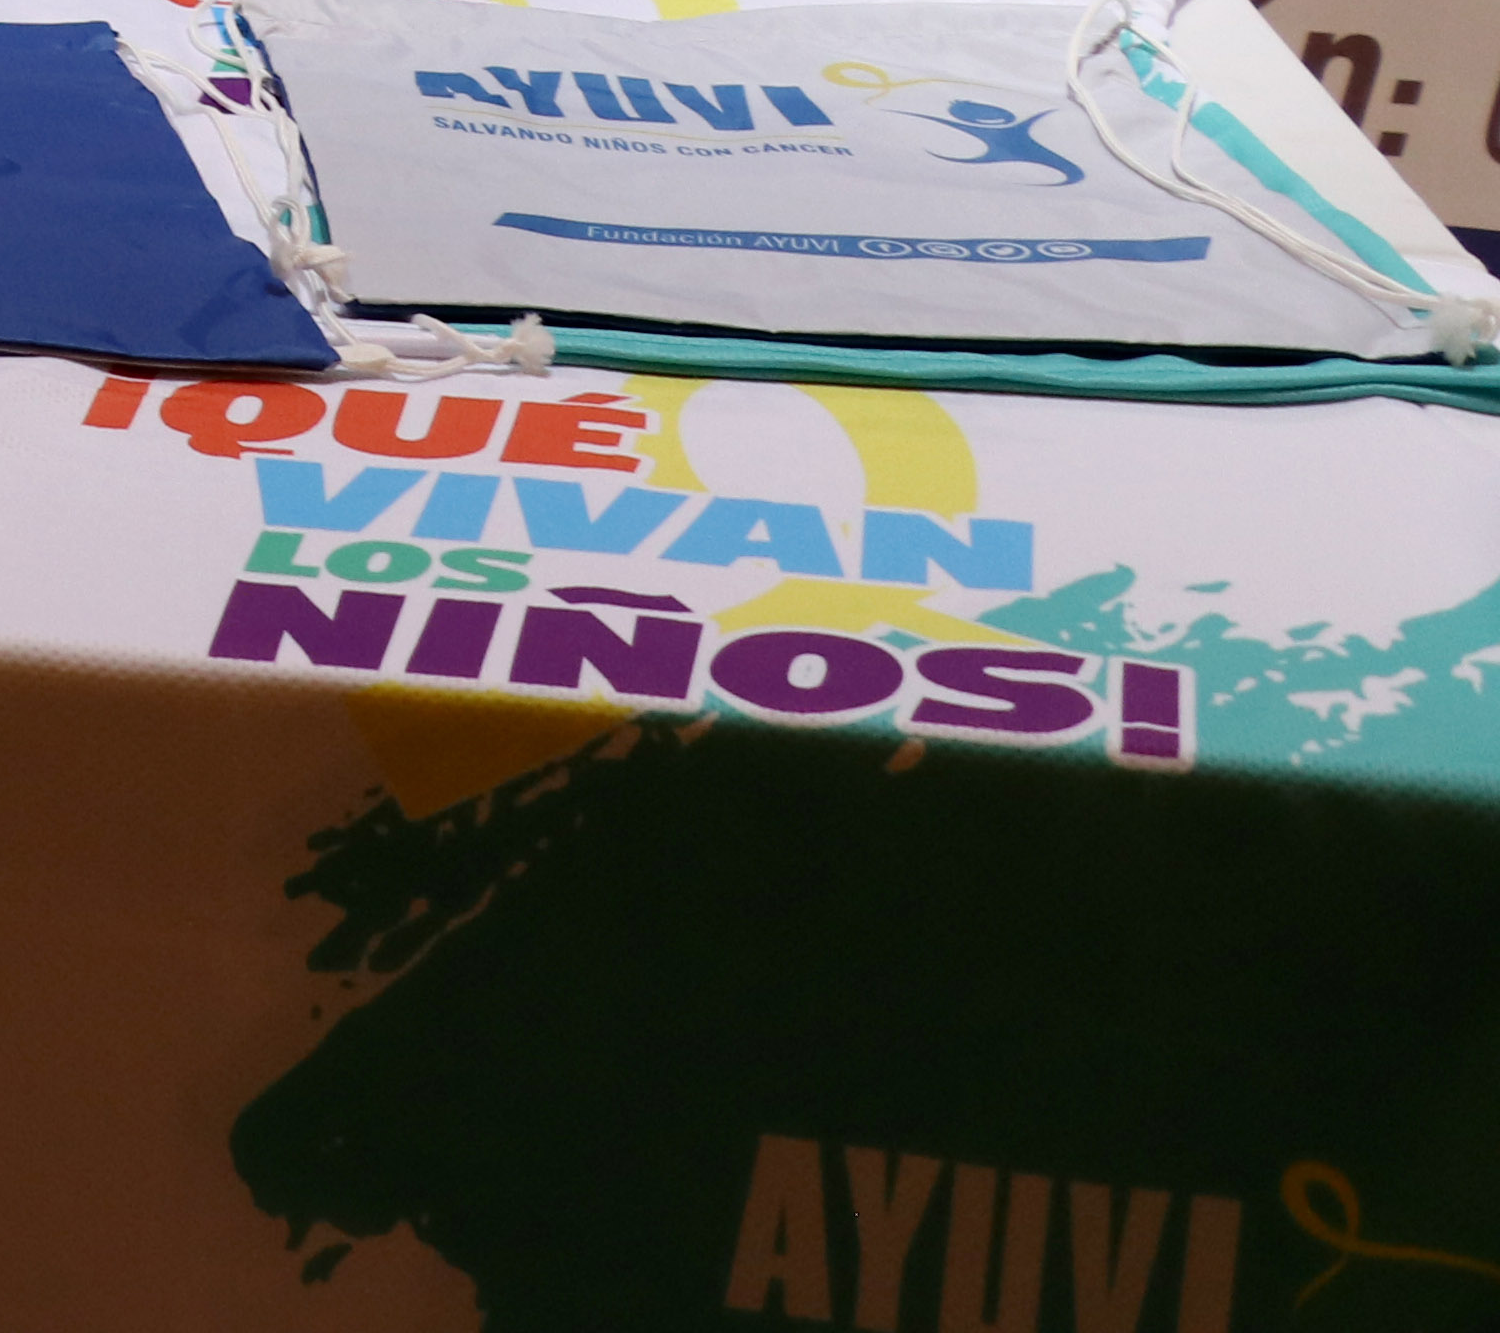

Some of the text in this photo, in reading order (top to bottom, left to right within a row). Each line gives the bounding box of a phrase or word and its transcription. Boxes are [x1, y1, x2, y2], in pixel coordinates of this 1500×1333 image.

[414, 65, 836, 132] AYUVI
[432, 115, 855, 158] SALVANDO NIÑOS CON CÁNCER
[586, 225, 842, 254] Fundación AYUVI
[82, 376, 648, 476] ¡QUÉ
[242, 529, 535, 594] LOS
[255, 458, 1036, 593] VIVAN
[208, 579, 1182, 760] NIÑOS!
[724, 1133, 1243, 1333] AYUVI
